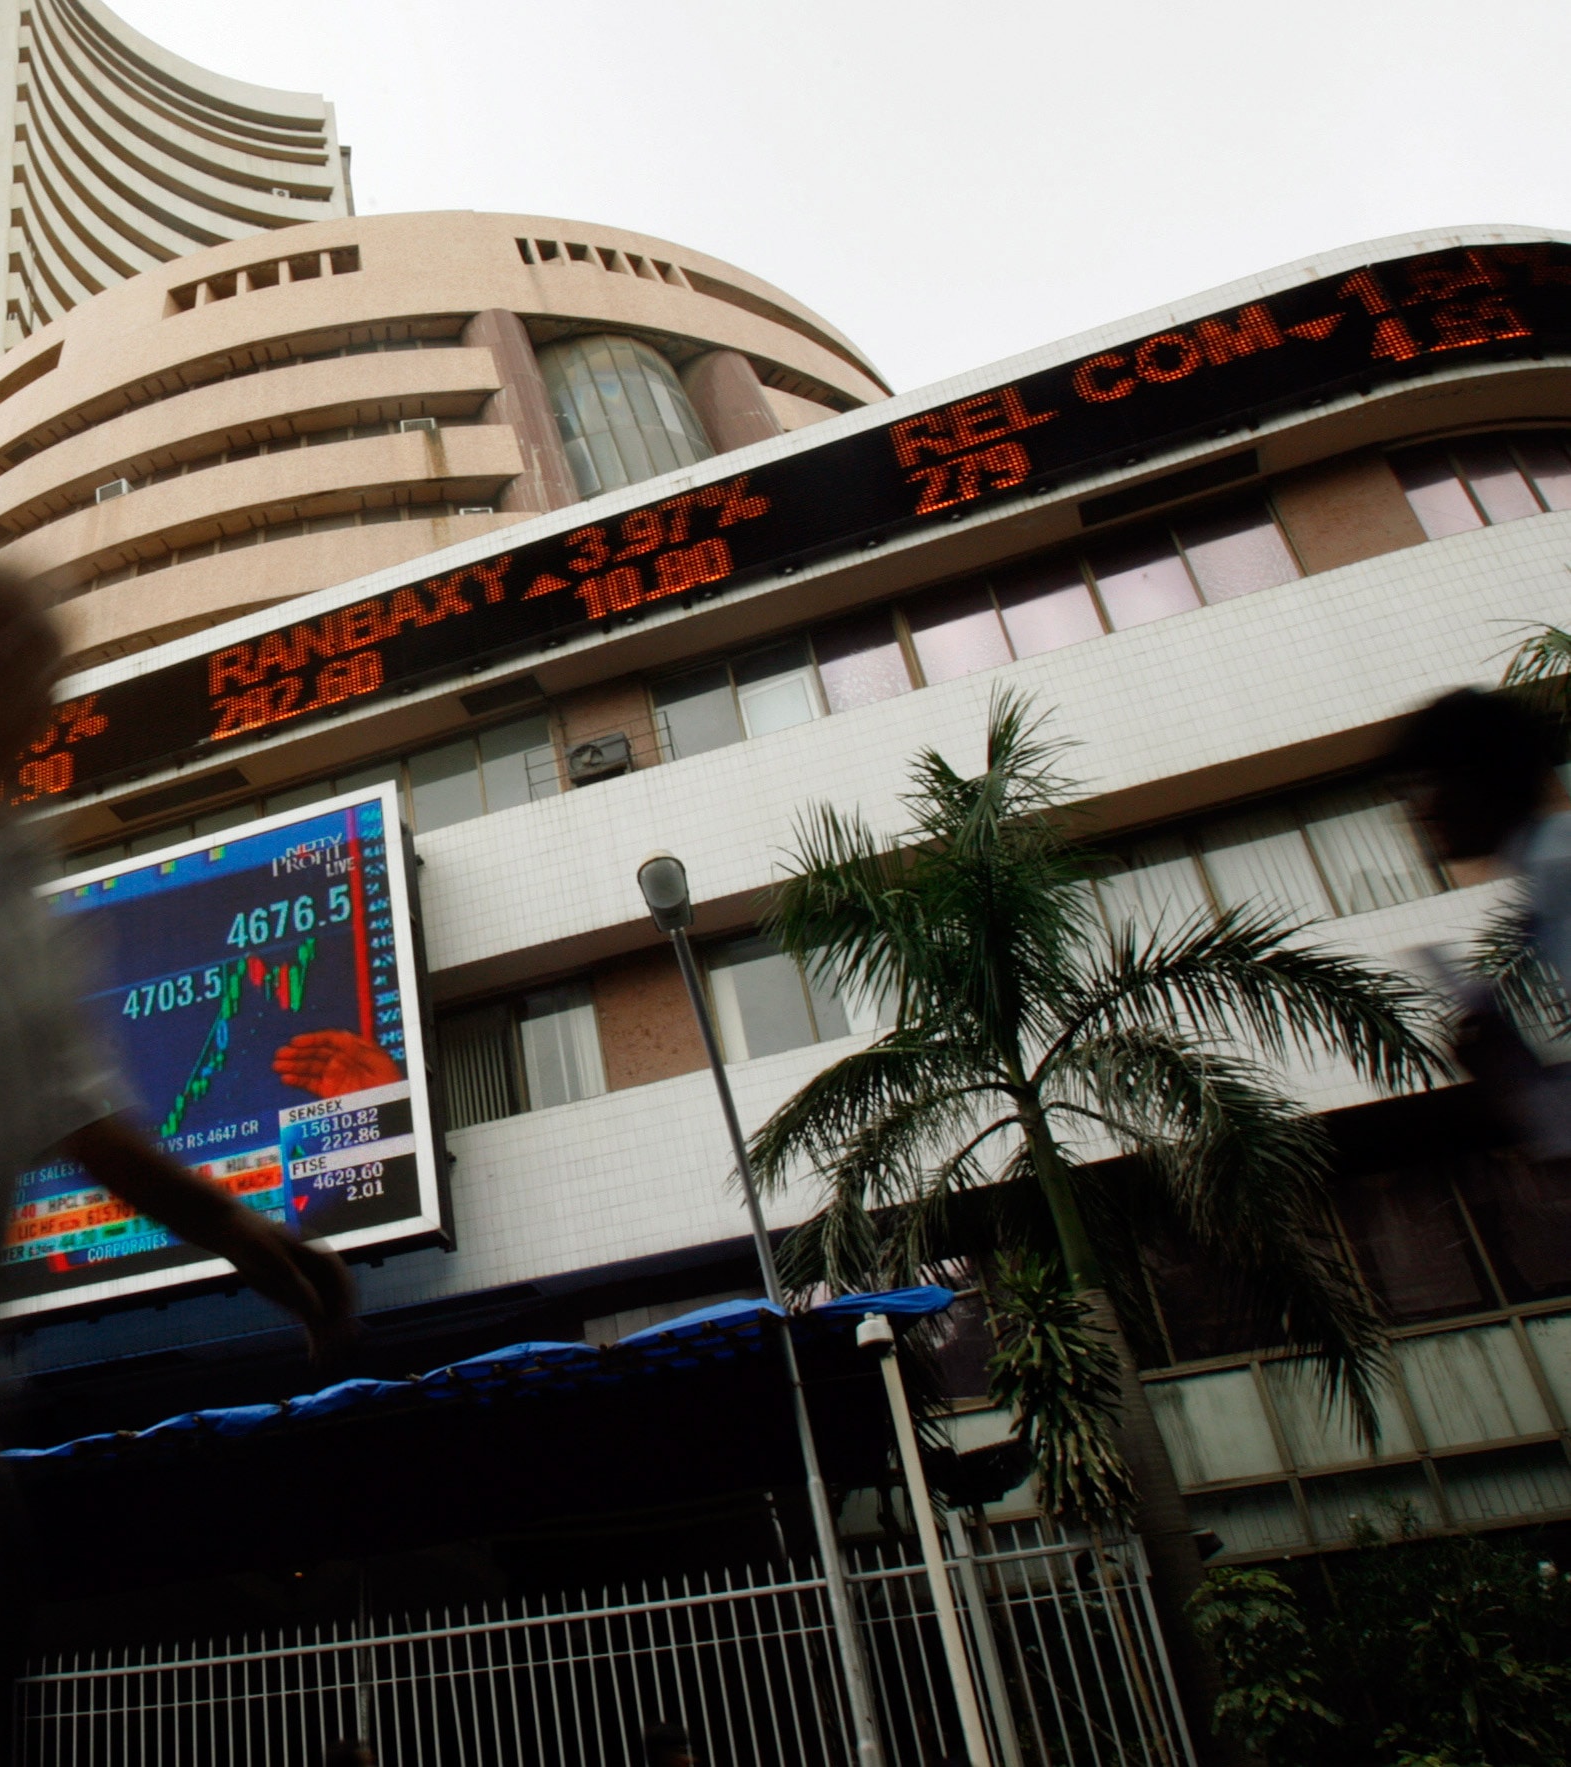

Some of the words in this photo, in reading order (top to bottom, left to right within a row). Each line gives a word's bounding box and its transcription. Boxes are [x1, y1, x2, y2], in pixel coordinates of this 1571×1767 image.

[889, 386, 1060, 468] REL
[1072, 303, 1287, 403] COM
[905, 441, 1032, 516] 279
[208, 554, 513, 696] RANBAXY
[564, 475, 772, 573] 3.97%
[574, 537, 734, 620] 10.80
[285, 833, 343, 858] NDTV
[272, 845, 341, 878] PROFIT
[325, 856, 356, 878] LIVE
[227, 884, 351, 948] 4676.5
[122, 967, 222, 1019] 4703.5
[289, 1099, 343, 1122] SENSEX
[301, 1108, 379, 1138] 15610.82
[39, 1162, 75, 1183] SALES
[168, 1136, 184, 1153] VS
[241, 1119, 259, 1137] CR
[321, 1125, 381, 1152] 222.86
[292, 1156, 328, 1176] FTSE
[313, 1161, 384, 1190] 4629.60
[347, 1180, 384, 1201] 2.01
[87, 1232, 168, 1263] CORPORATES
